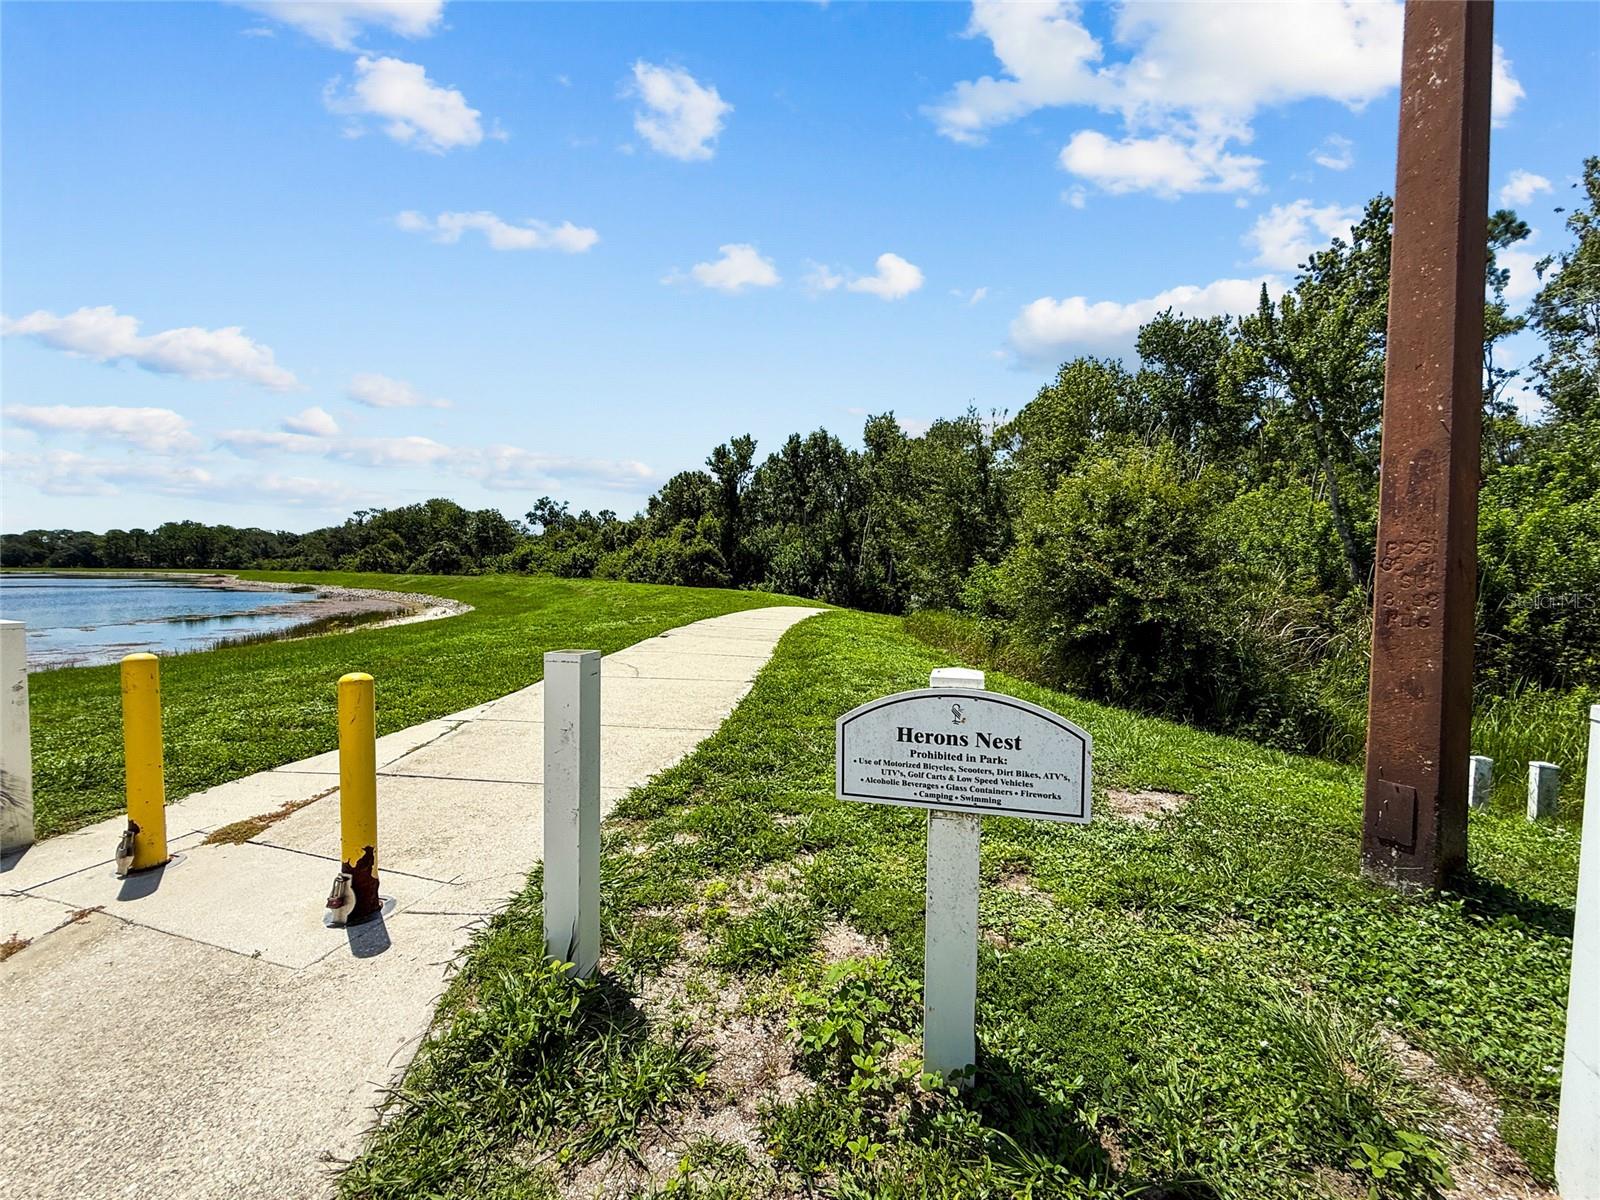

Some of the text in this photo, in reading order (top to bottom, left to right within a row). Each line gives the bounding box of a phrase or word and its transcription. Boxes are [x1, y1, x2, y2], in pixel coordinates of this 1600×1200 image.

[896, 727, 1022, 751] Herons Nest
[910, 749, 1008, 765] Prohibited in Park:
[858, 758, 872, 766] Use
[883, 760, 921, 769] Motorized
[923, 763, 957, 773] Bicycles,
[958, 766, 995, 776] Scooters,
[997, 769, 1014, 777] Dirt
[1016, 770, 1041, 779] Bikes,
[865, 777, 1062, 800] Alcoholic Beverages Glass Containers Fireworks
[908, 770, 925, 779] Golf
[926, 772, 947, 781] Carts
[957, 775, 972, 783] Low
[974, 777, 998, 786] Speed
[1000, 779, 1034, 788] Vehicles
[919, 791, 1002, 806] Camping Swimming
